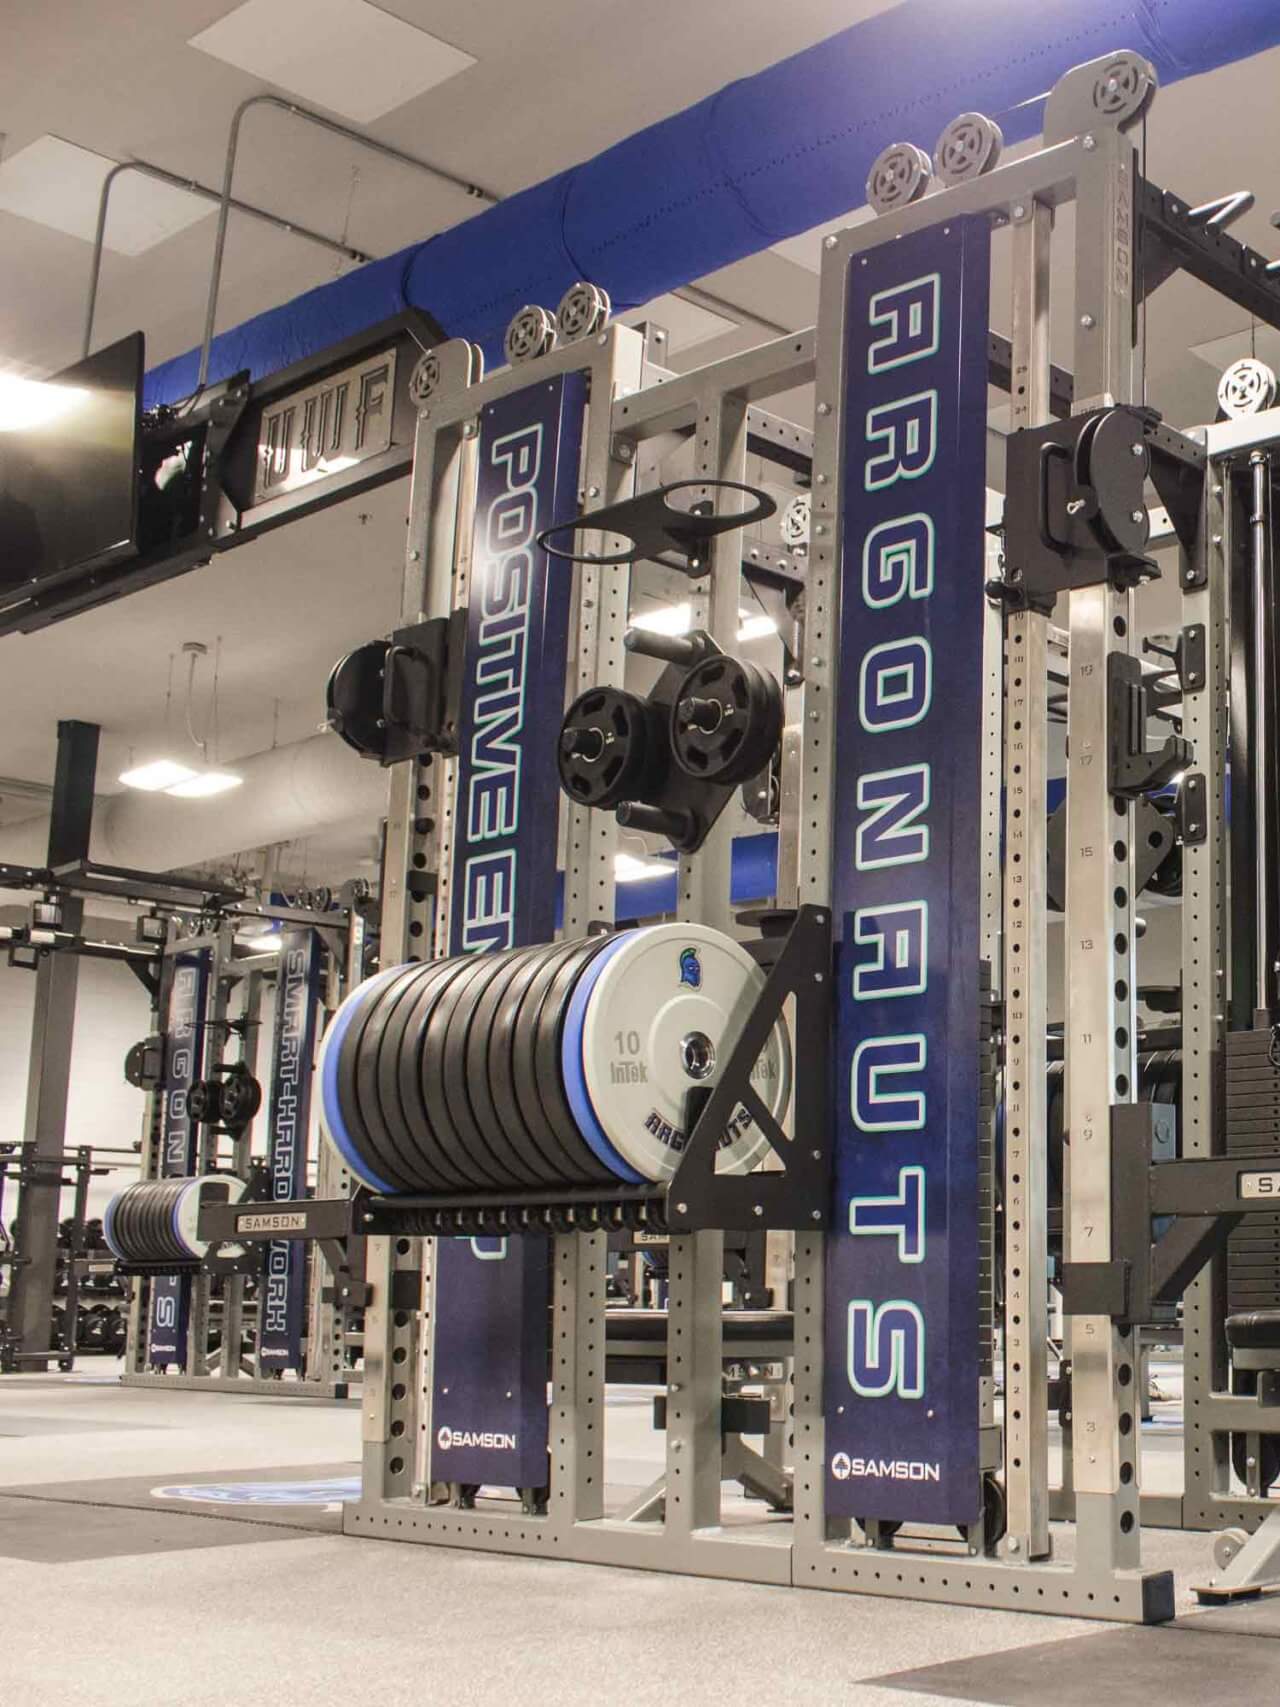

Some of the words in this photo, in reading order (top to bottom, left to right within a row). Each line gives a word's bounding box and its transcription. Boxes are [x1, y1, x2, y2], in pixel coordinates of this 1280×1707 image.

[467, 422, 544, 843] POSITIVE
[849, 272, 941, 1400] ARGONAUTS
[1079, 846, 1093, 858] 15
[1080, 939, 1094, 951] 13
[613, 1030, 640, 1055] 10
[1082, 1033, 1092, 1045] 11
[610, 1061, 648, 1084] InTek
[244, 1215, 300, 1229] SAMSON
[1084, 1226, 1094, 1239] 7
[1085, 1323, 1095, 1335] 5
[1086, 1421, 1096, 1433] 3
[452, 1429, 516, 1449] SAMSON
[851, 1458, 940, 1481] SAMSON
